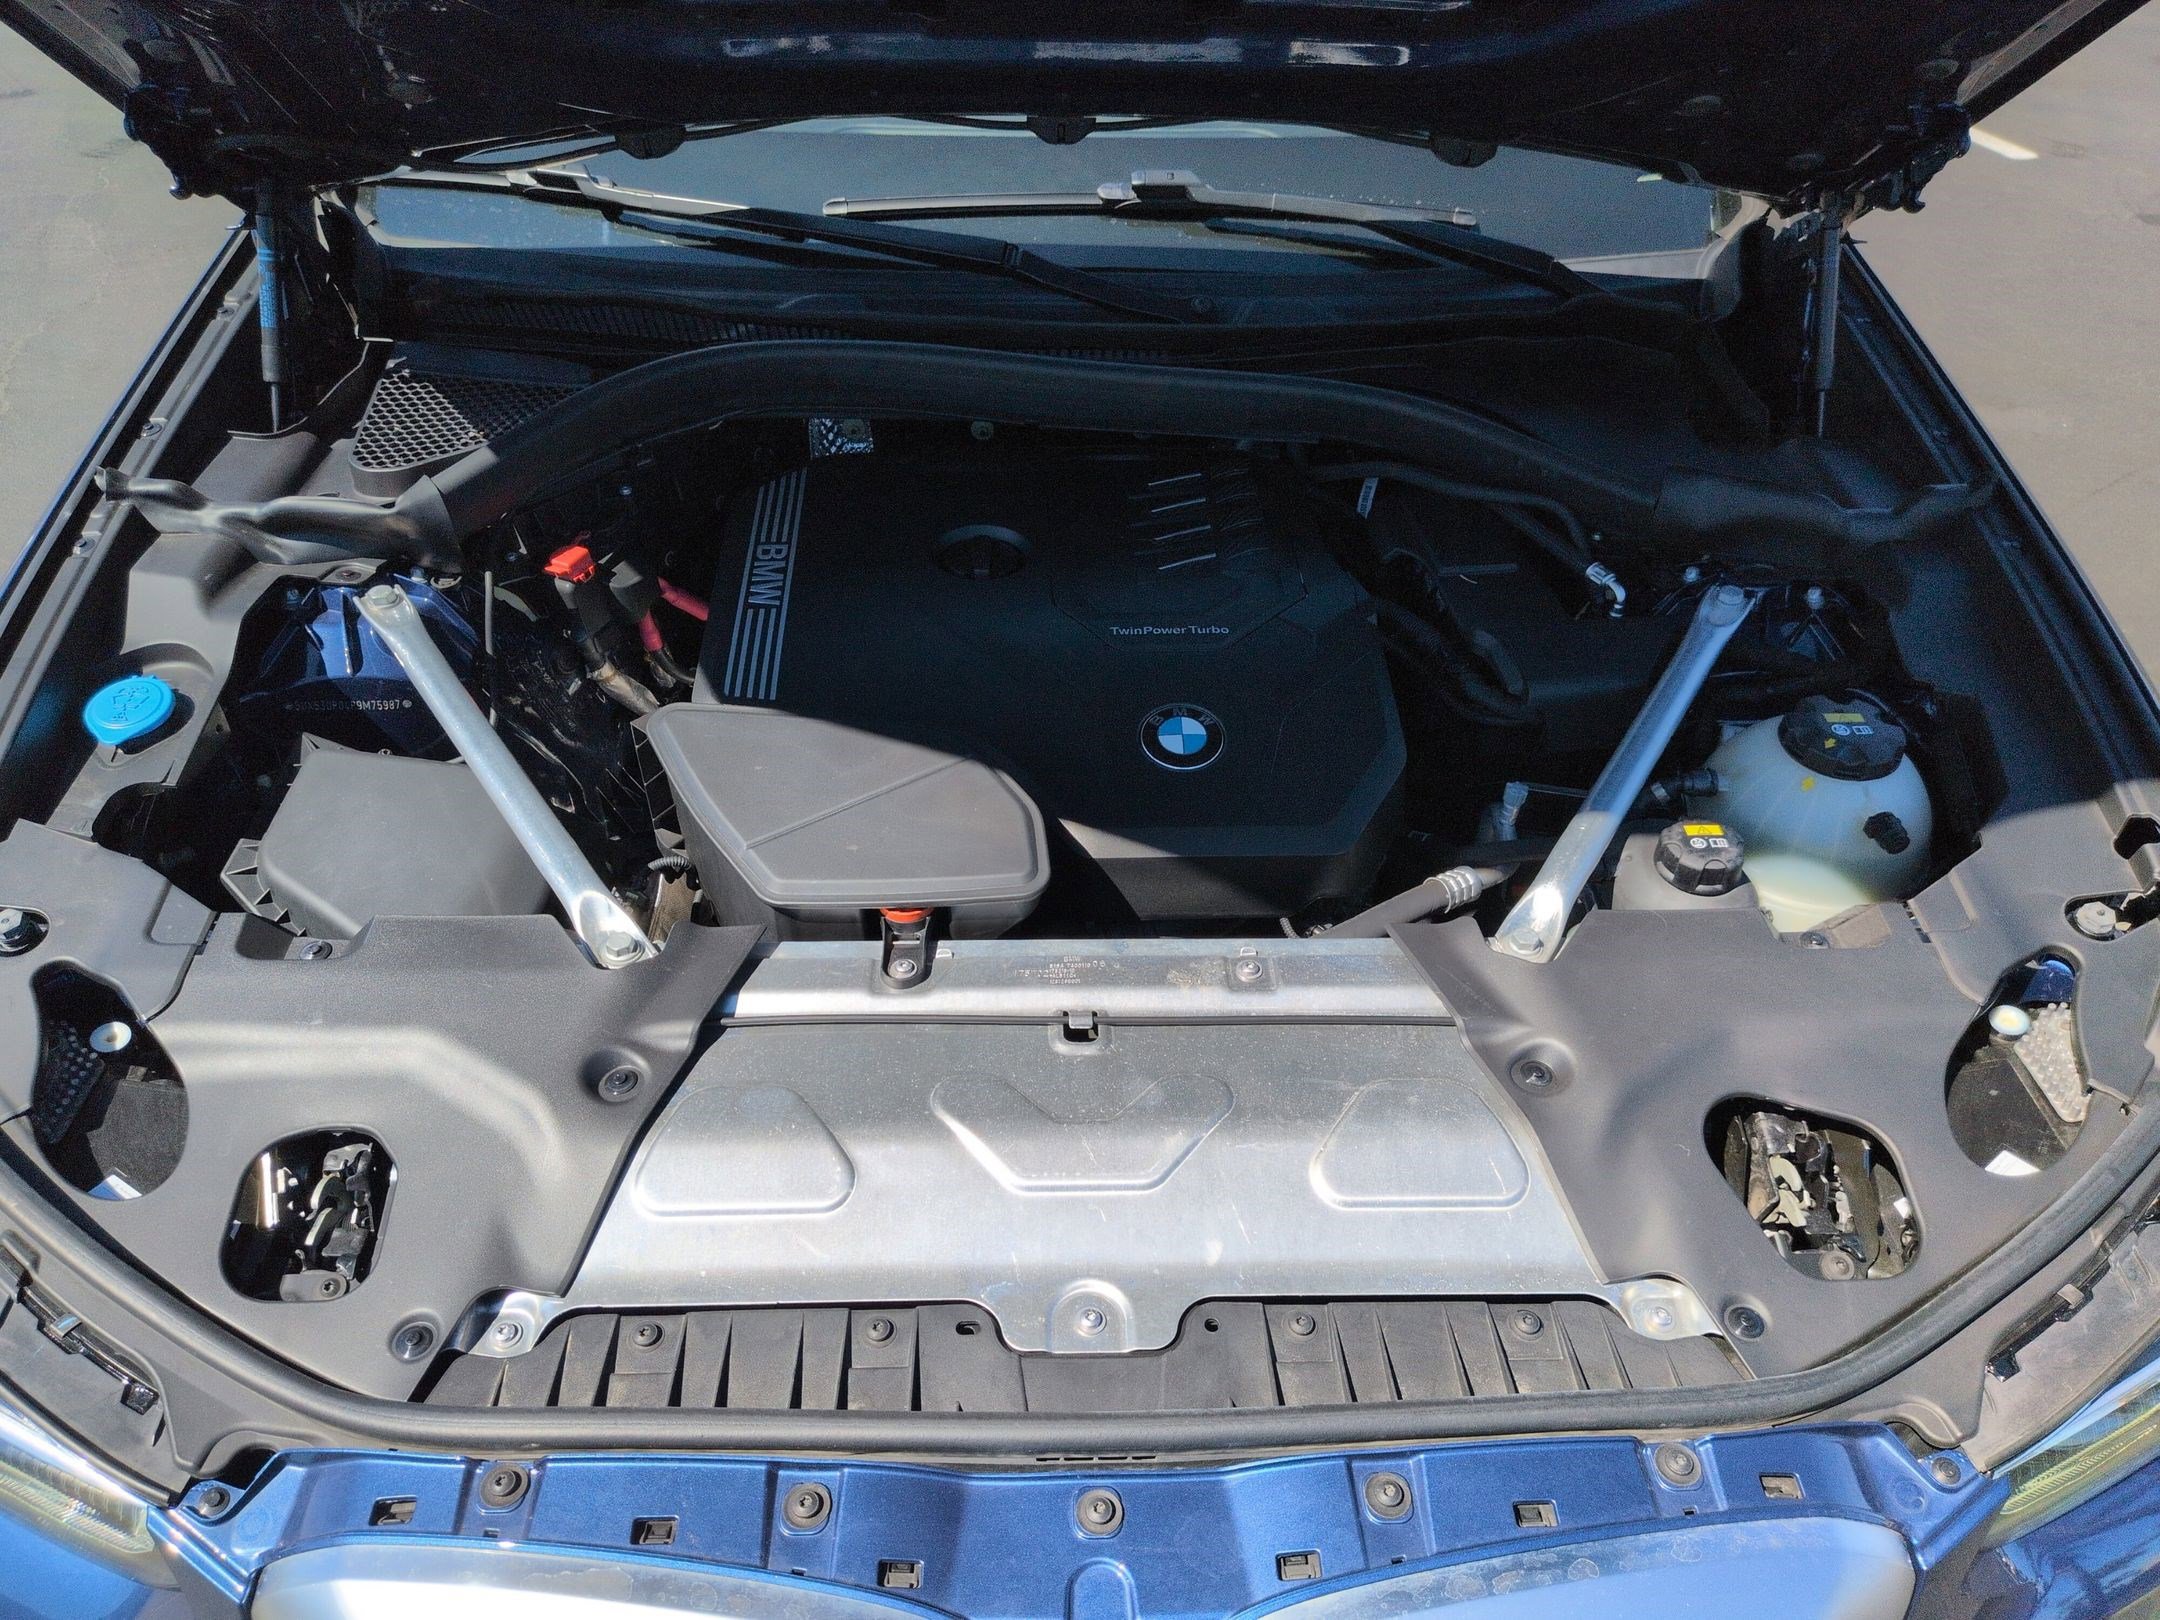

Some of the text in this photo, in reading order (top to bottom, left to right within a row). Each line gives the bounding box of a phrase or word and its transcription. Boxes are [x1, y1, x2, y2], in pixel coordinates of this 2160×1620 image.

[748, 543, 789, 606] BMW
[1109, 625, 1230, 636] TwinPower Turbo
[1150, 706, 1215, 726] BMW
